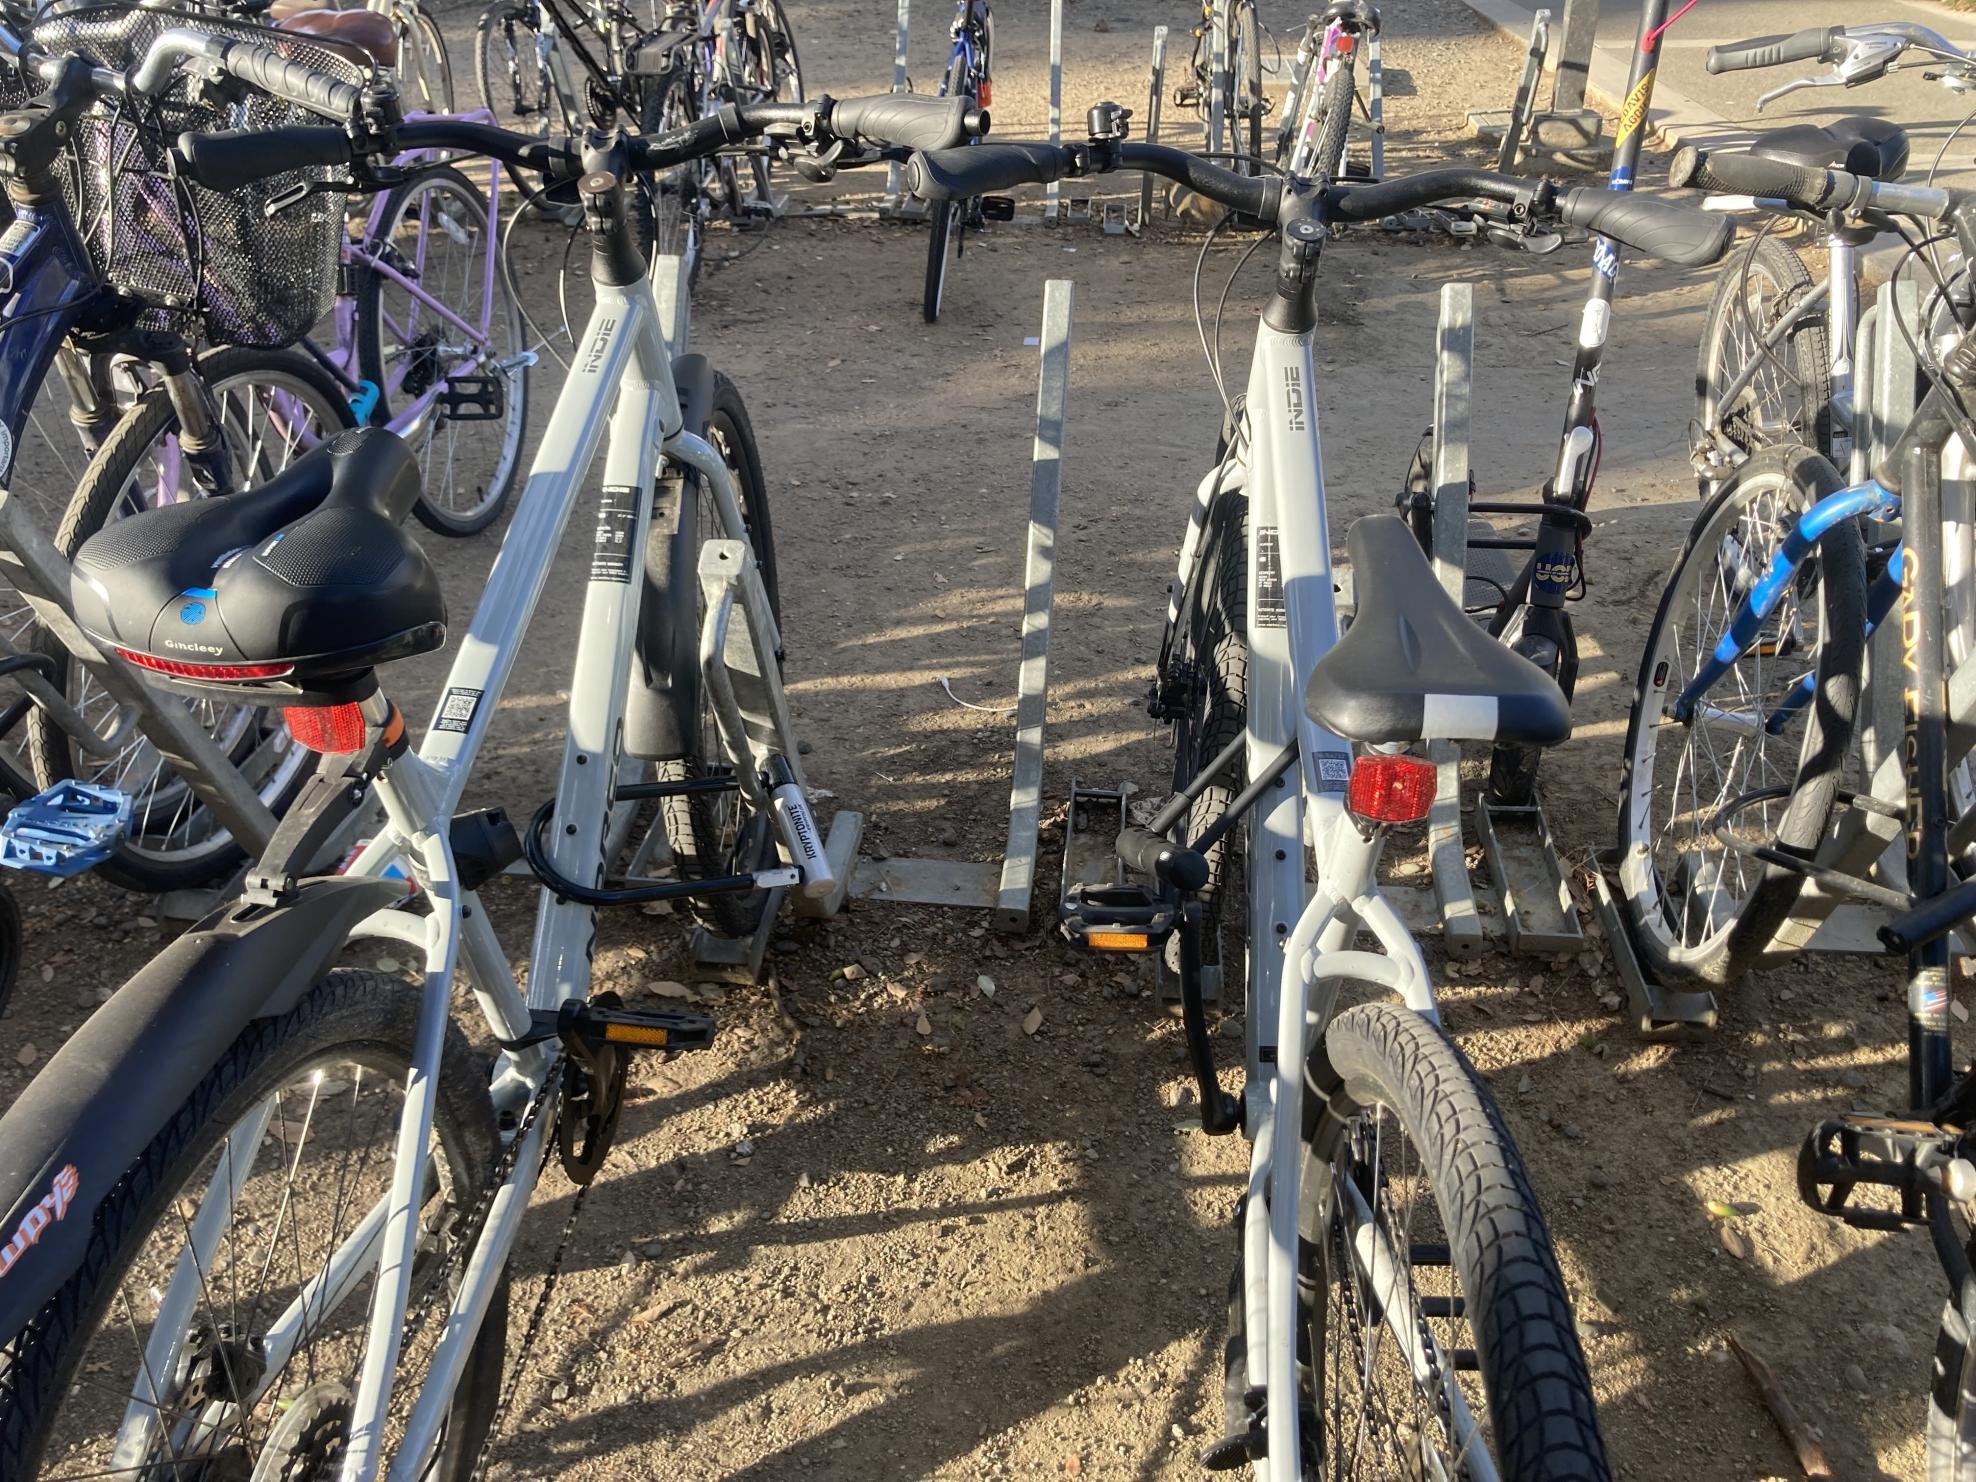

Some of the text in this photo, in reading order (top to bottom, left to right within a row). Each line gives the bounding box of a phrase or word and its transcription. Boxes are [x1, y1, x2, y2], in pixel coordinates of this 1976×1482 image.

[582, 319, 616, 373] INDIE
[1284, 366, 1305, 431] INDIE
[165, 640, 223, 656] Gincleey
[788, 804, 816, 859] KRYPTONITE
